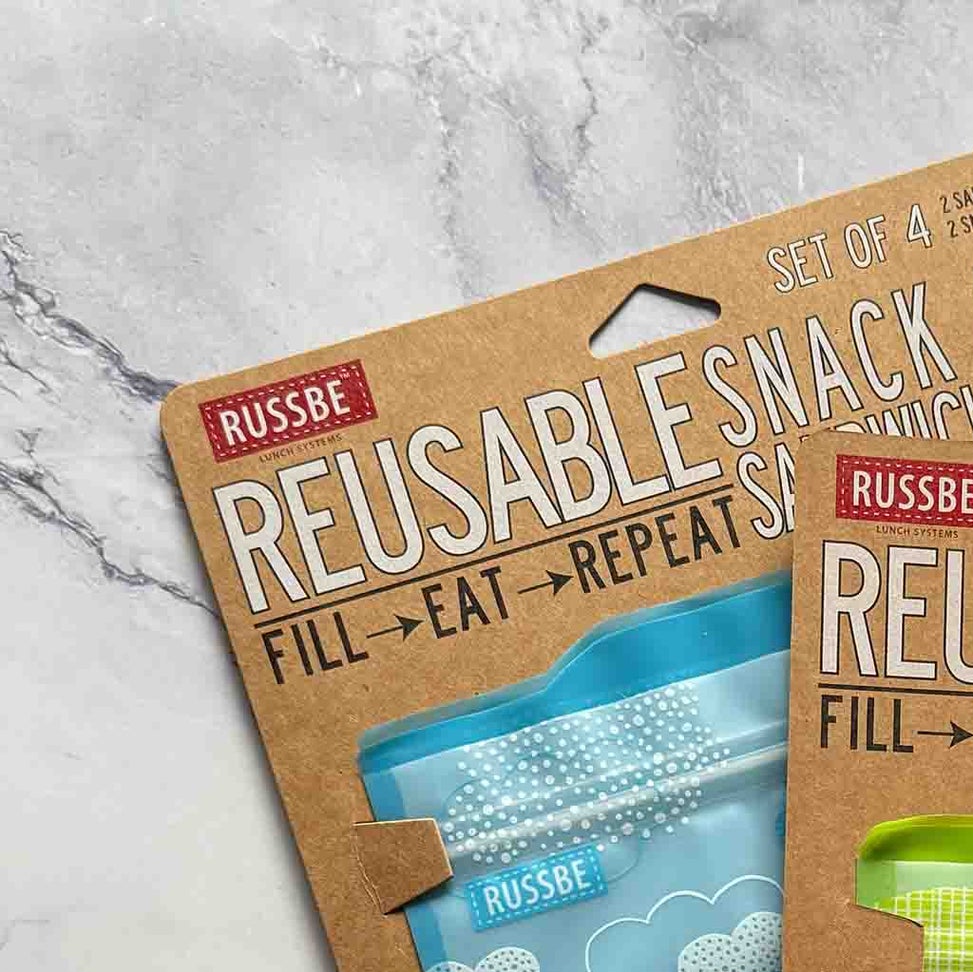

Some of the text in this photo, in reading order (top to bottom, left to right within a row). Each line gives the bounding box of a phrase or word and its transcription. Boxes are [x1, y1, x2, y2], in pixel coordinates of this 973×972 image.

[939, 195, 951, 214] 2
[946, 220, 958, 238] 2
[767, 203, 934, 293] SET OF 4
[700, 281, 957, 448] SNACK
[259, 433, 344, 464] LUNCH SYSTEMS
[212, 351, 724, 614] REUSABLE
[876, 525, 959, 539] LUNCH SYSTEMS
[262, 496, 742, 685] FILL EAT REPEAT
[819, 694, 915, 755] FILL
[482, 858, 592, 917] RUSSBE
